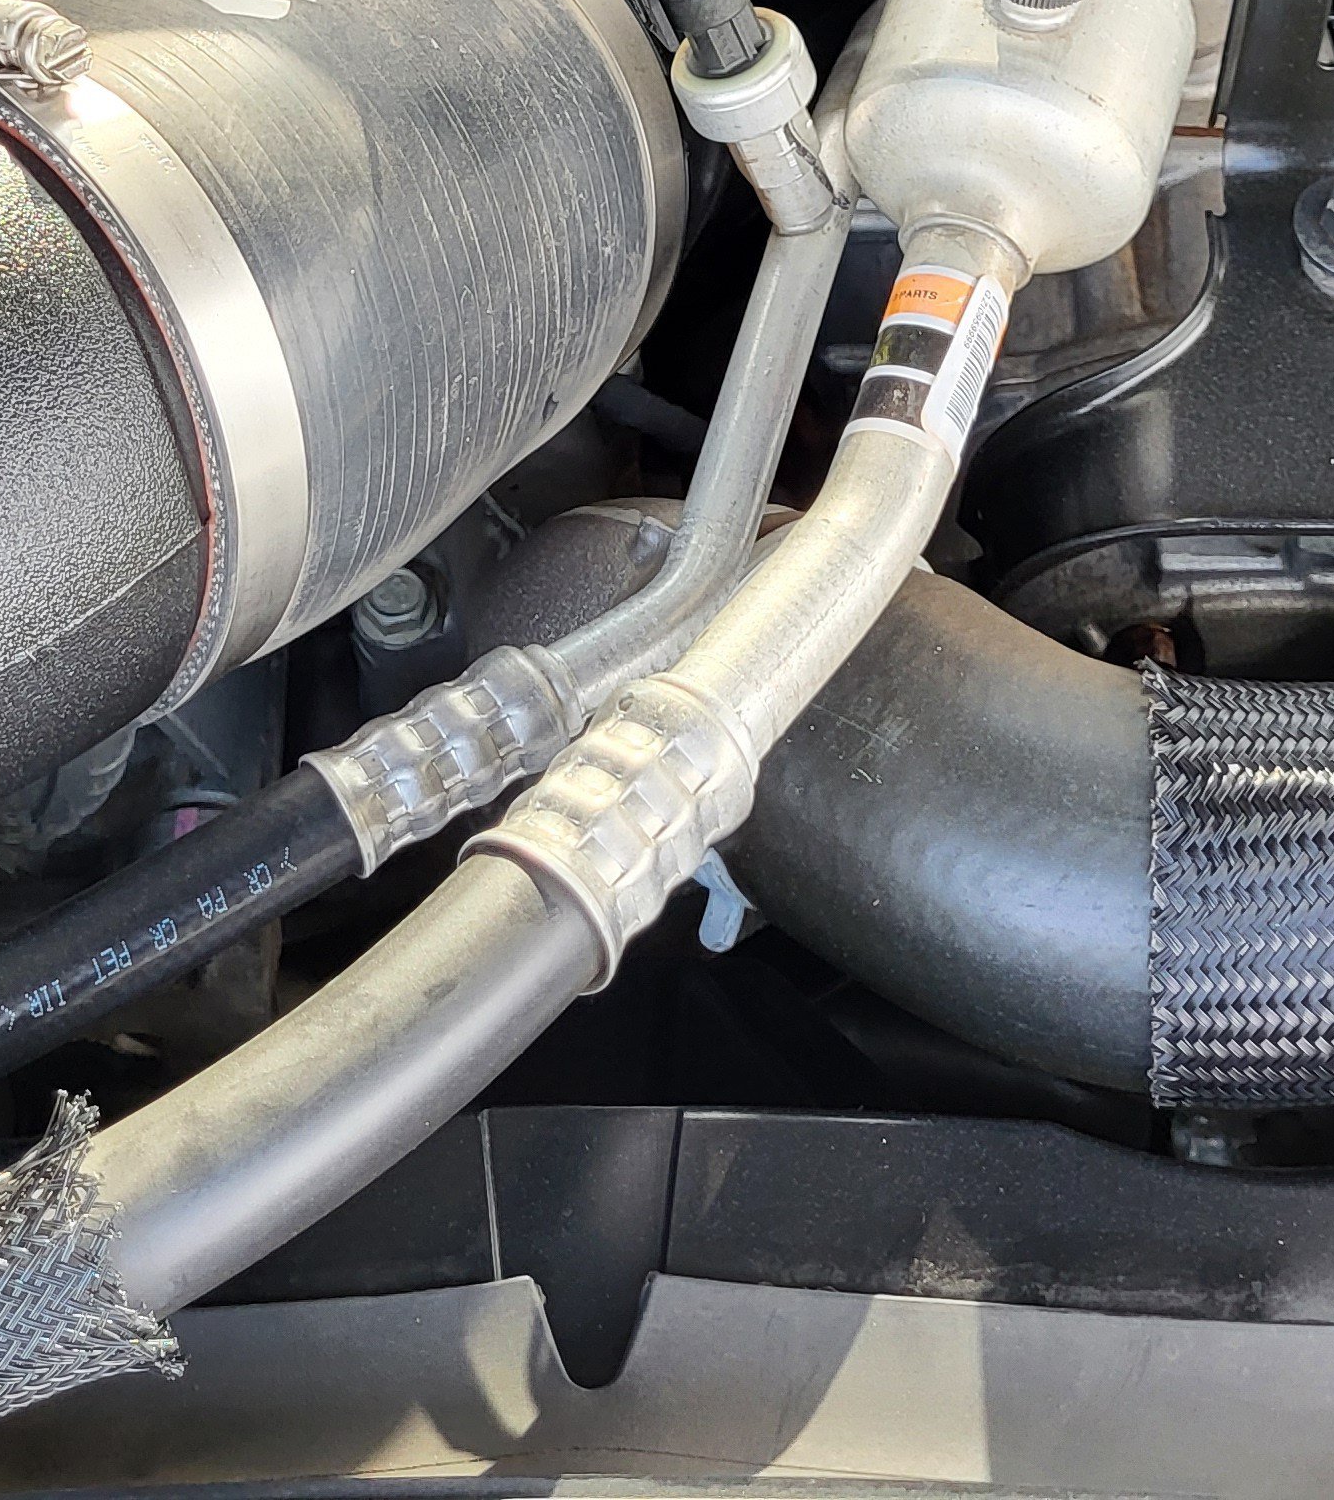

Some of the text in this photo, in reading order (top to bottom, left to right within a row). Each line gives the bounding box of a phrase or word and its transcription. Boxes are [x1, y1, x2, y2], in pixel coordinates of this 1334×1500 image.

[242, 861, 273, 895] CR
[147, 916, 178, 951] CR
[91, 939, 133, 986] PET
